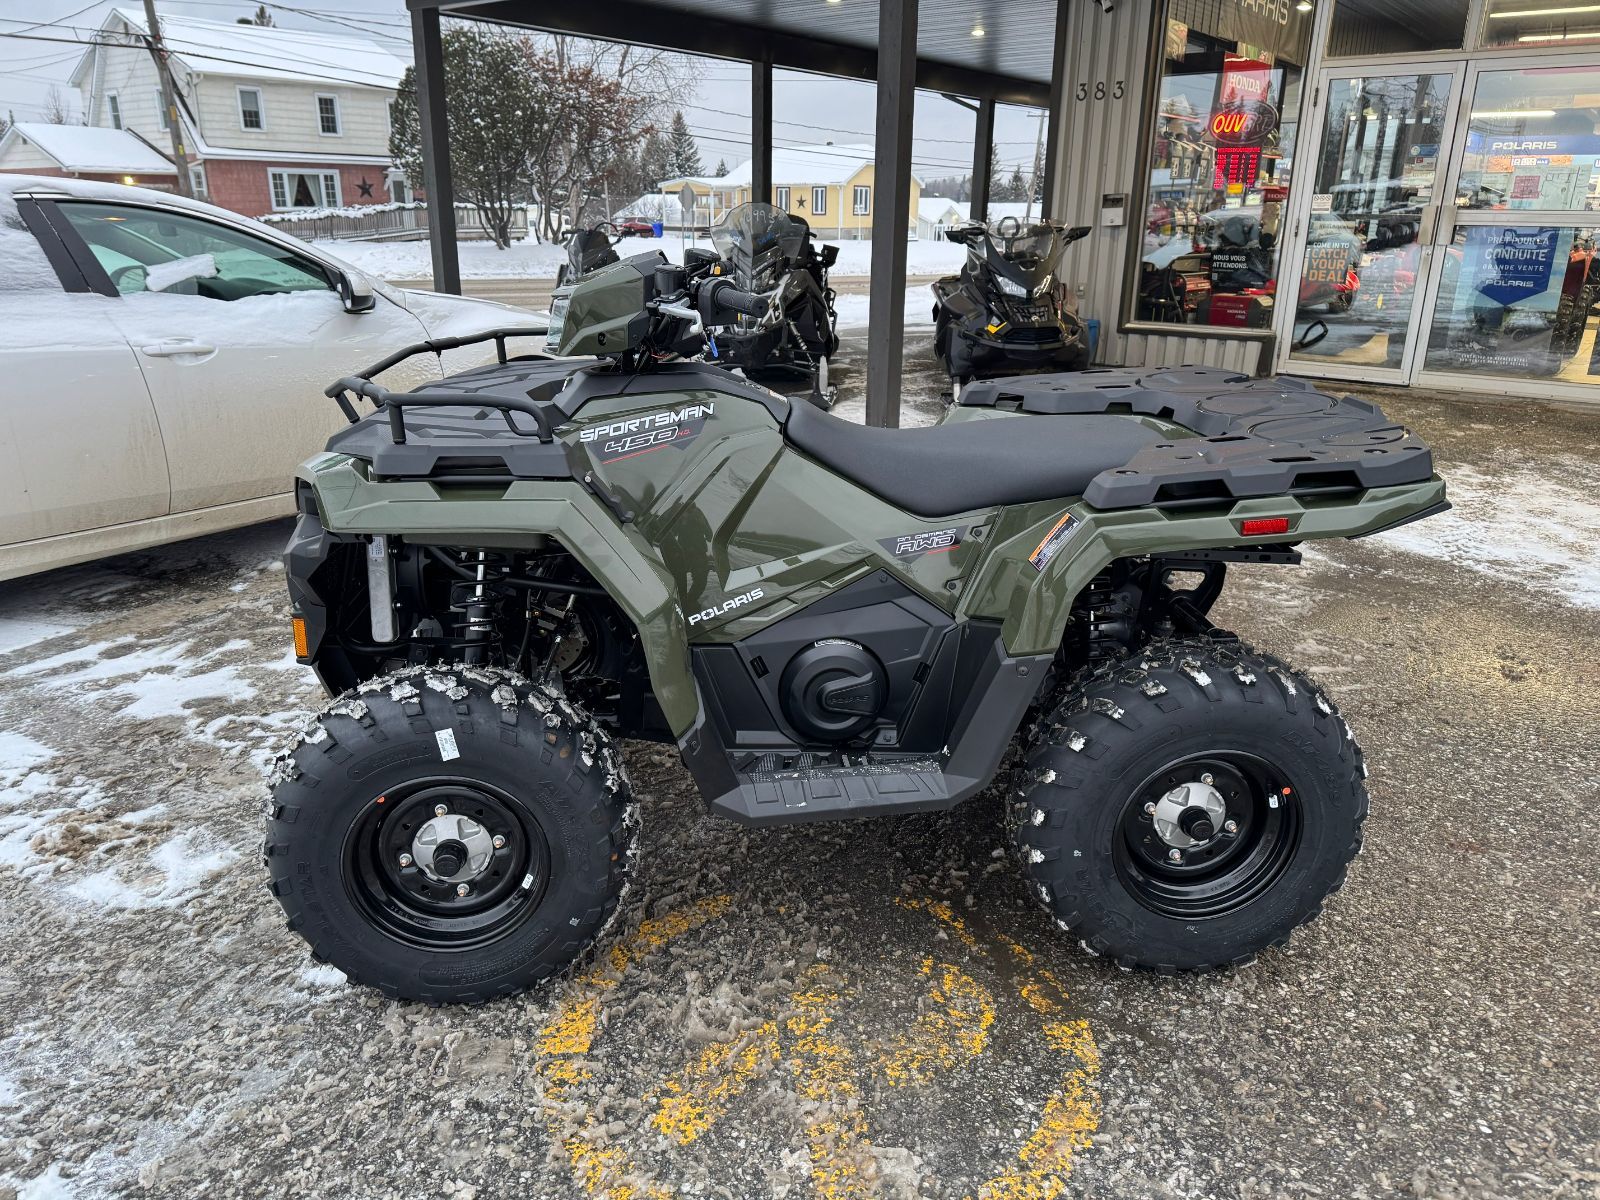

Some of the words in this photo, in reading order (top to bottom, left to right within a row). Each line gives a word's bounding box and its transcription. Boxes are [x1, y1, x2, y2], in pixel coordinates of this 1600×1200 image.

[1234, 0, 1289, 25] ARRIS
[1229, 74, 1261, 93] HONDA
[1492, 141, 1558, 151] POLARIS
[1512, 237, 1536, 245] POUR
[1311, 248, 1349, 259] CATCH
[1484, 247, 1549, 261] CONDUITE
[1212, 261, 1249, 269] ATTENDONS.
[1312, 259, 1345, 269] YOUR
[1485, 279, 1534, 288] POLARIS
[579, 403, 715, 443] SPORTSMAN
[605, 426, 678, 452] 450
[915, 530, 956, 540] DEMAND
[896, 536, 955, 553] AWD
[688, 587, 764, 626] POLARIS
